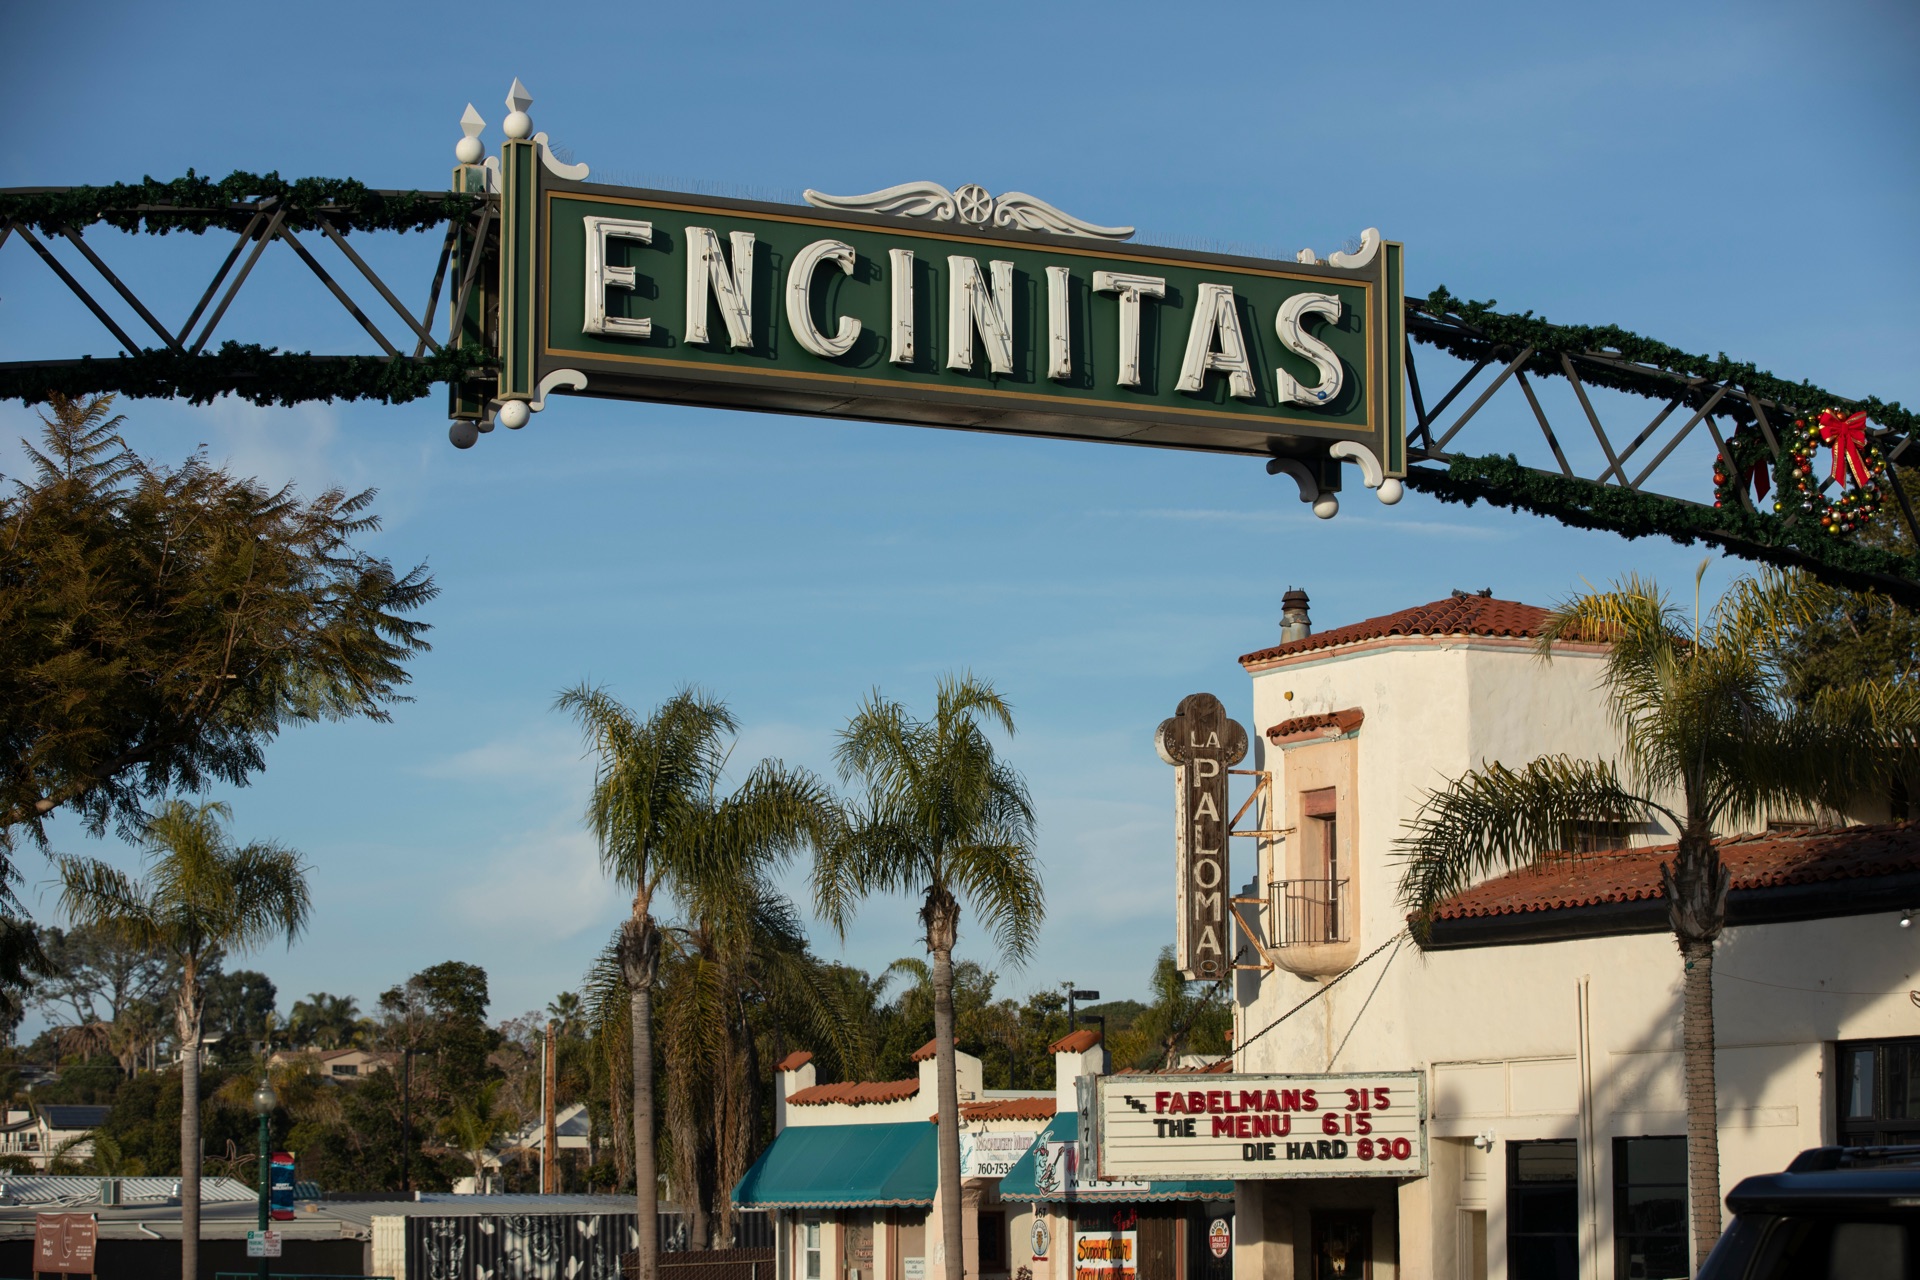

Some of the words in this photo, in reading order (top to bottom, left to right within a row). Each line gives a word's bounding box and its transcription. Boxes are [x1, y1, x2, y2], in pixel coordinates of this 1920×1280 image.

[582, 215, 1344, 406] ENCINITAS
[1190, 730, 1221, 749] LA
[1193, 757, 1222, 956] PALOMA
[1123, 1095, 1147, 1113] THE
[1155, 1088, 1319, 1115] FABELMANS
[1344, 1087, 1391, 1112] 315
[1081, 1106, 1090, 1162] 471
[1153, 1118, 1196, 1138] THE
[1212, 1114, 1291, 1139] MENU
[1322, 1112, 1373, 1136] 615
[1242, 1142, 1276, 1162] DIE
[1286, 1139, 1349, 1160] HARD
[1357, 1137, 1412, 1161] 830
[1035, 1207, 1047, 1219] 467
[1211, 1221, 1228, 1234] GUITAR
[1077, 1236, 1108, 1263] Support
[1107, 1237, 1130, 1263] Your
